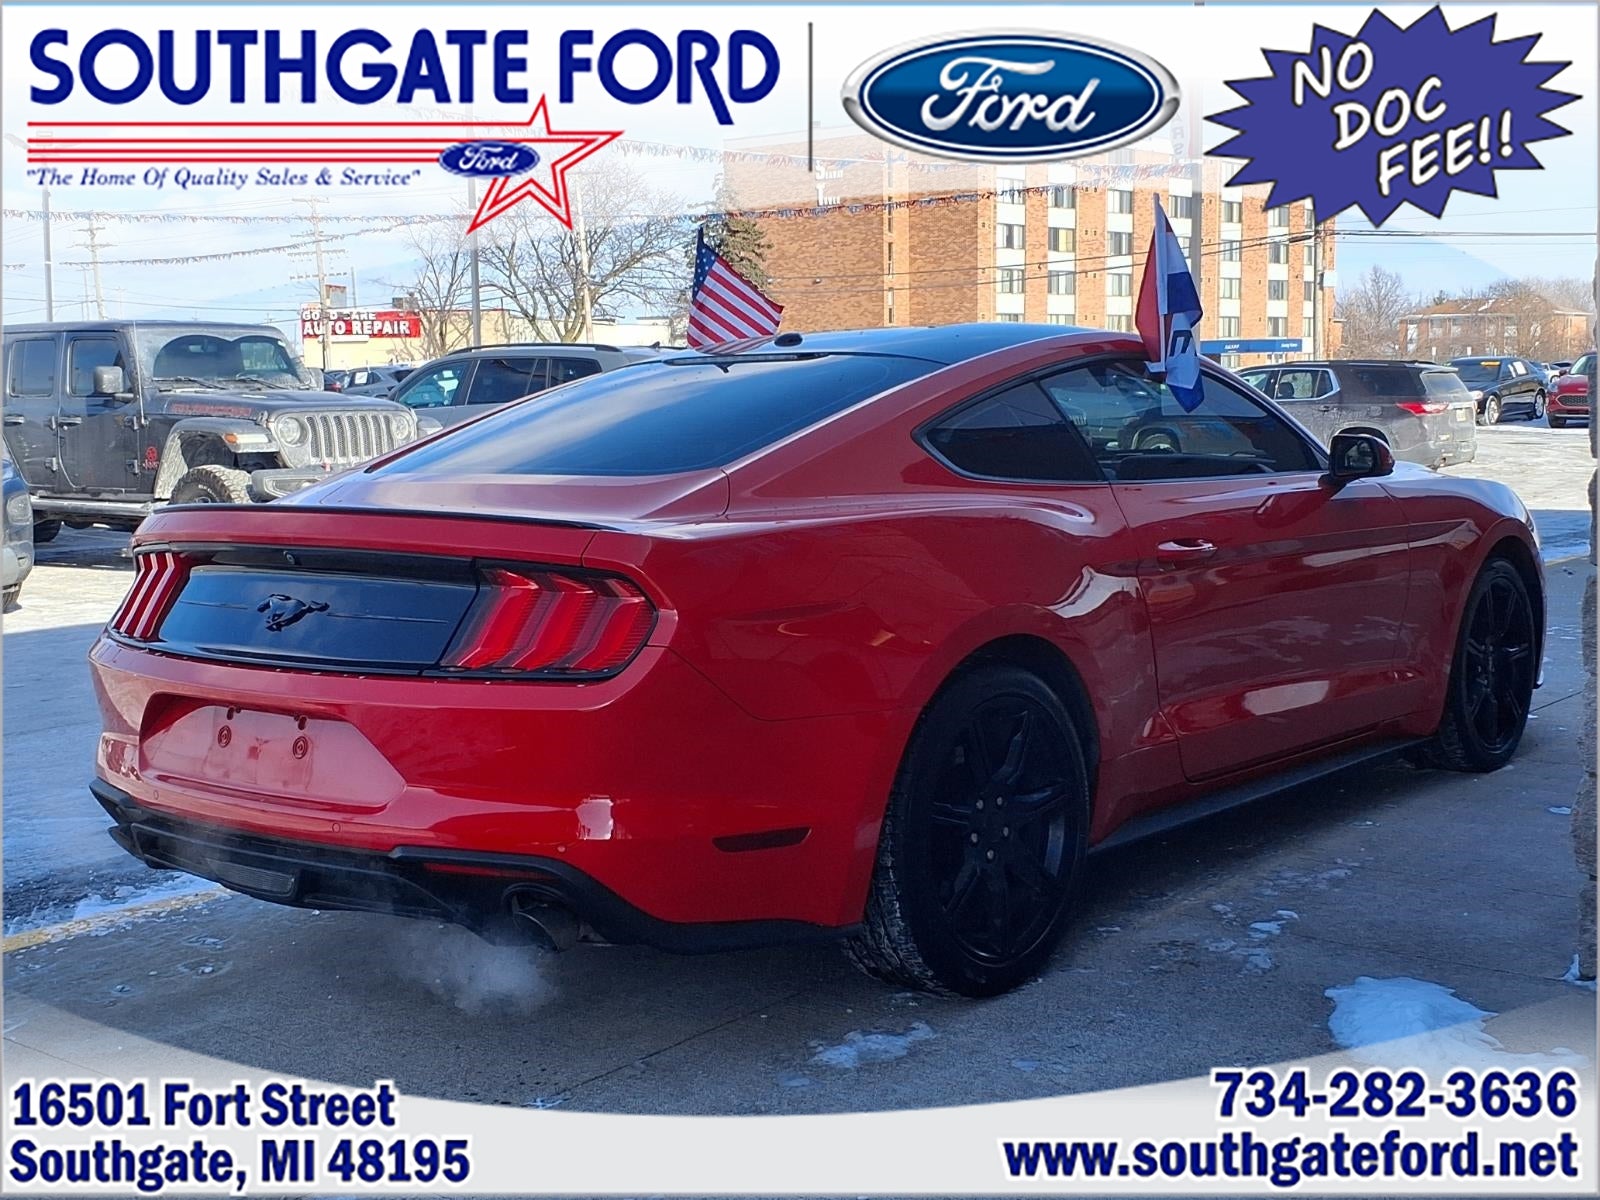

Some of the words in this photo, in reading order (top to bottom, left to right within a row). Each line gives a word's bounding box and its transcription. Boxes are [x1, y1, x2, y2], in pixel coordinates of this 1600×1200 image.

[302, 309, 338, 320] GOD
[303, 321, 346, 335] AUTO
[352, 321, 411, 335] REPAIR
